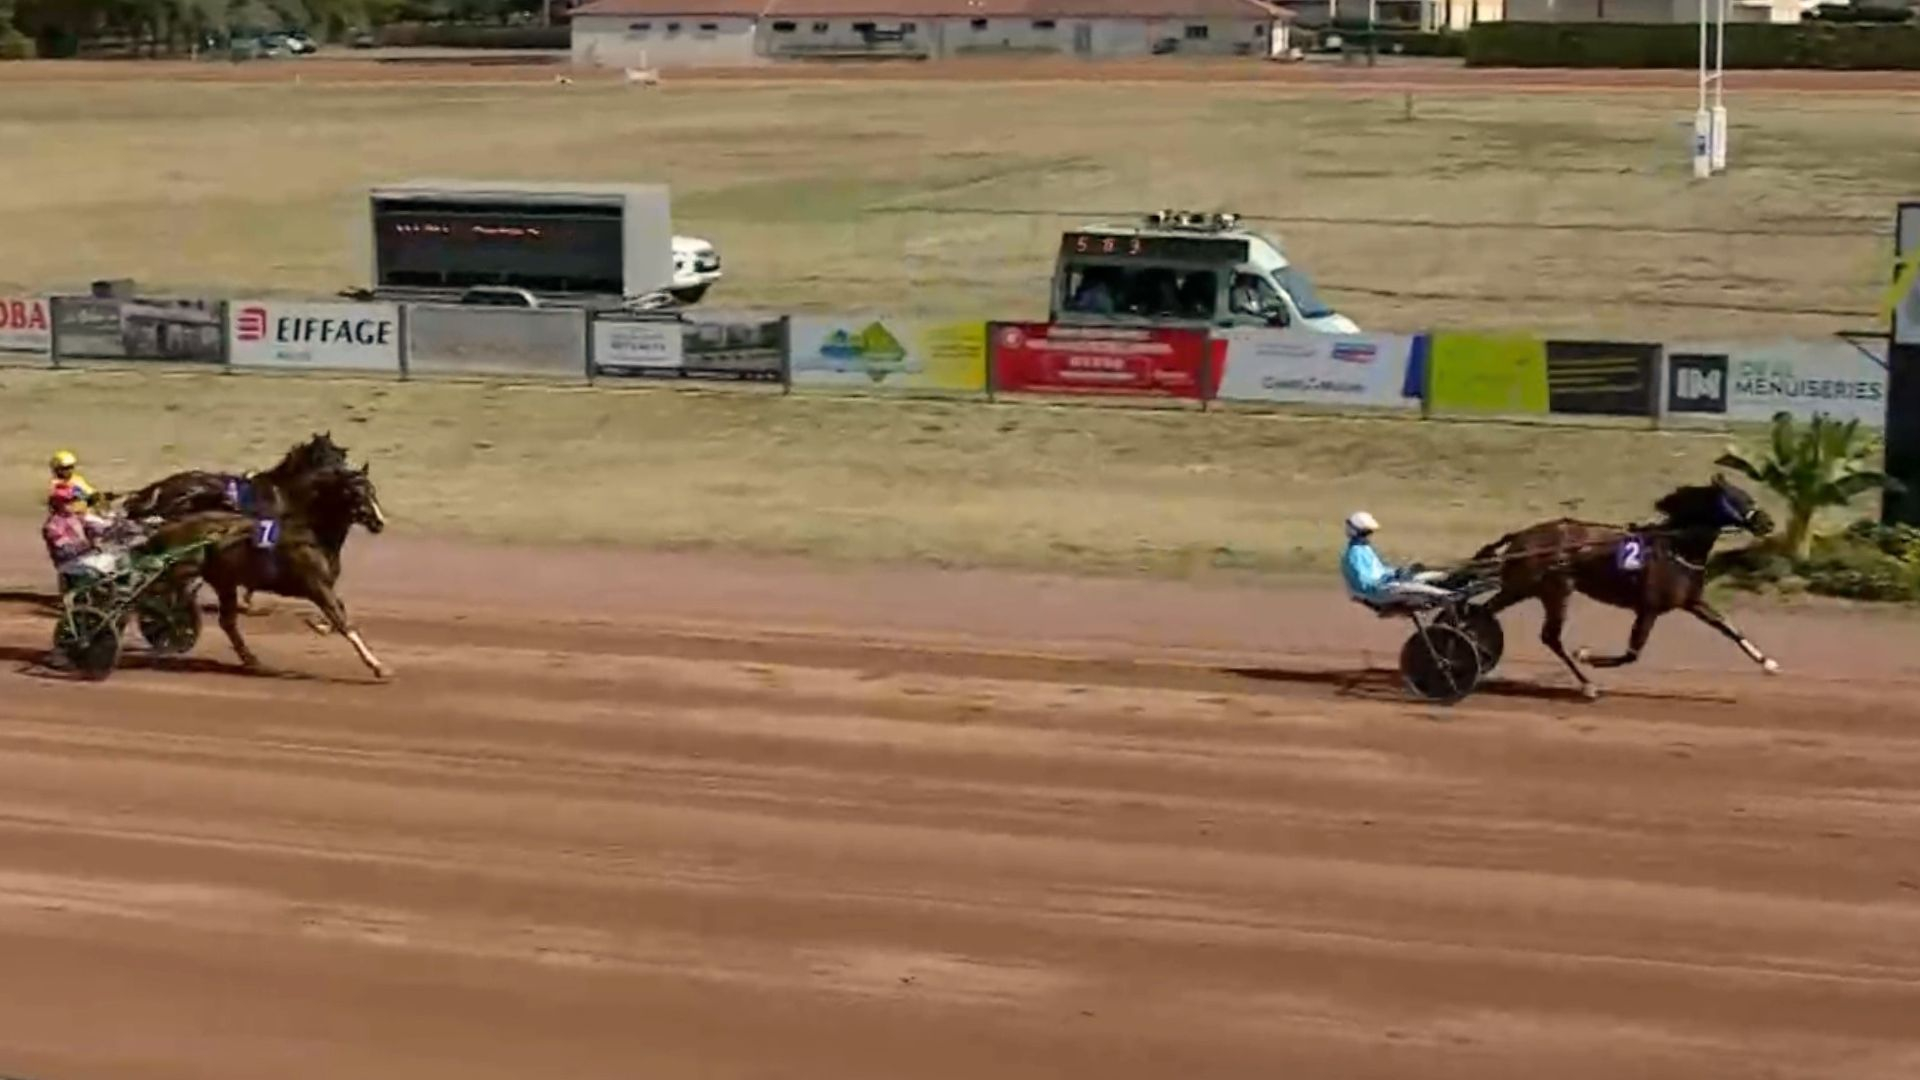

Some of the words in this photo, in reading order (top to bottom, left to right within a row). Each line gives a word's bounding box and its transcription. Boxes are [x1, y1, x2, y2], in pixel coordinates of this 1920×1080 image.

[277, 316, 392, 345] EIFFAGE
[1736, 377, 1884, 400] MENUISERIES
[257, 519, 274, 548] 7
[1623, 541, 1641, 570] 2
